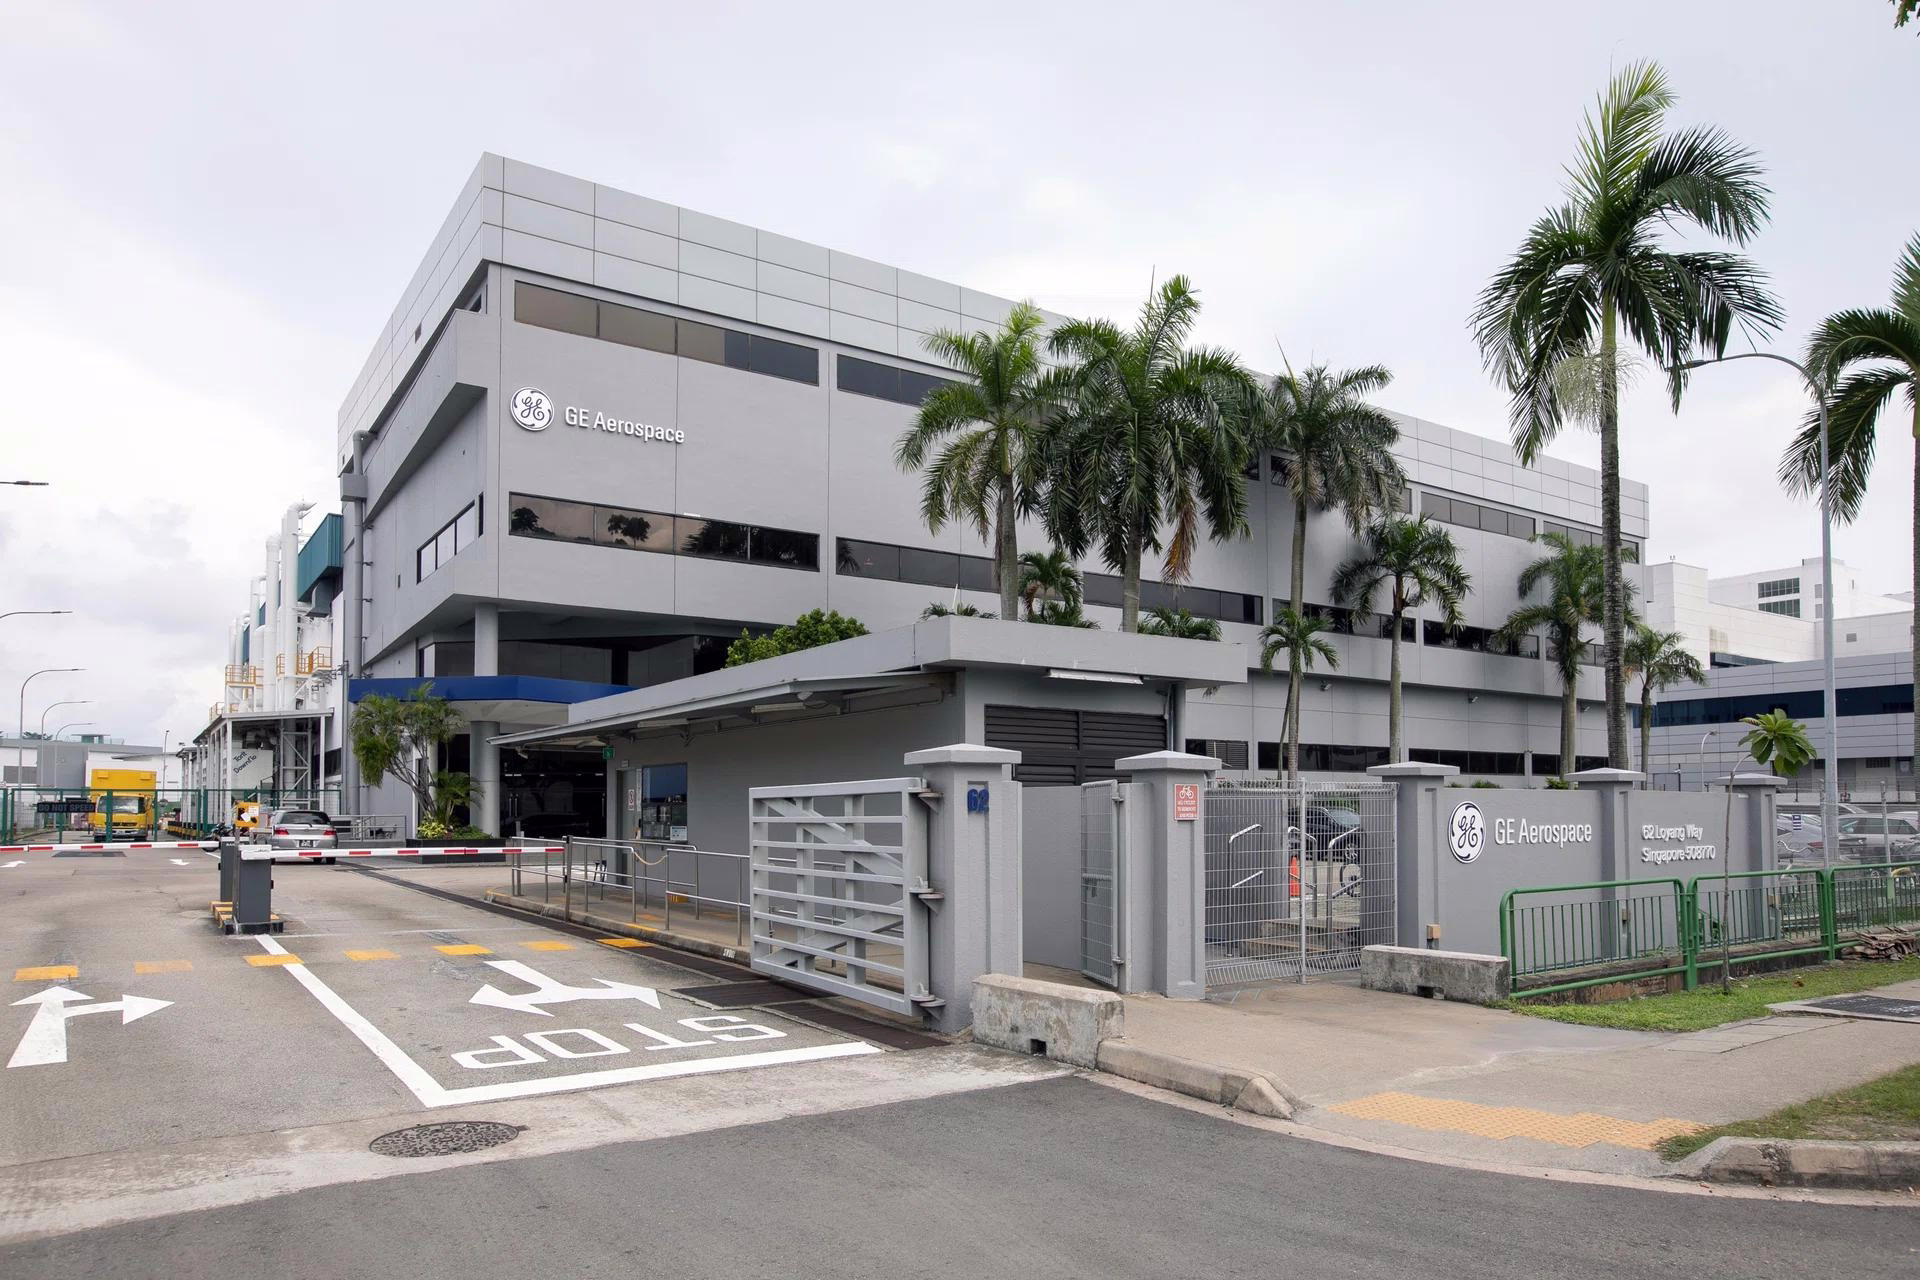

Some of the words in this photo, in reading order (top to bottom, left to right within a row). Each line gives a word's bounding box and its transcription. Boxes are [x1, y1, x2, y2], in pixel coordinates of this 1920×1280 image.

[565, 406, 589, 428] GE
[593, 412, 685, 443] Aerospace
[69, 803, 95, 812] SPEED
[967, 789, 989, 812] 62
[1495, 818, 1516, 844] GE
[1518, 818, 1592, 848] Aerospace
[1642, 824, 1655, 840] 62
[1655, 824, 1685, 841] Loyang
[1686, 824, 1704, 841] Way
[1642, 847, 1685, 865] Singapore
[451, 1016, 788, 1068] STOP
